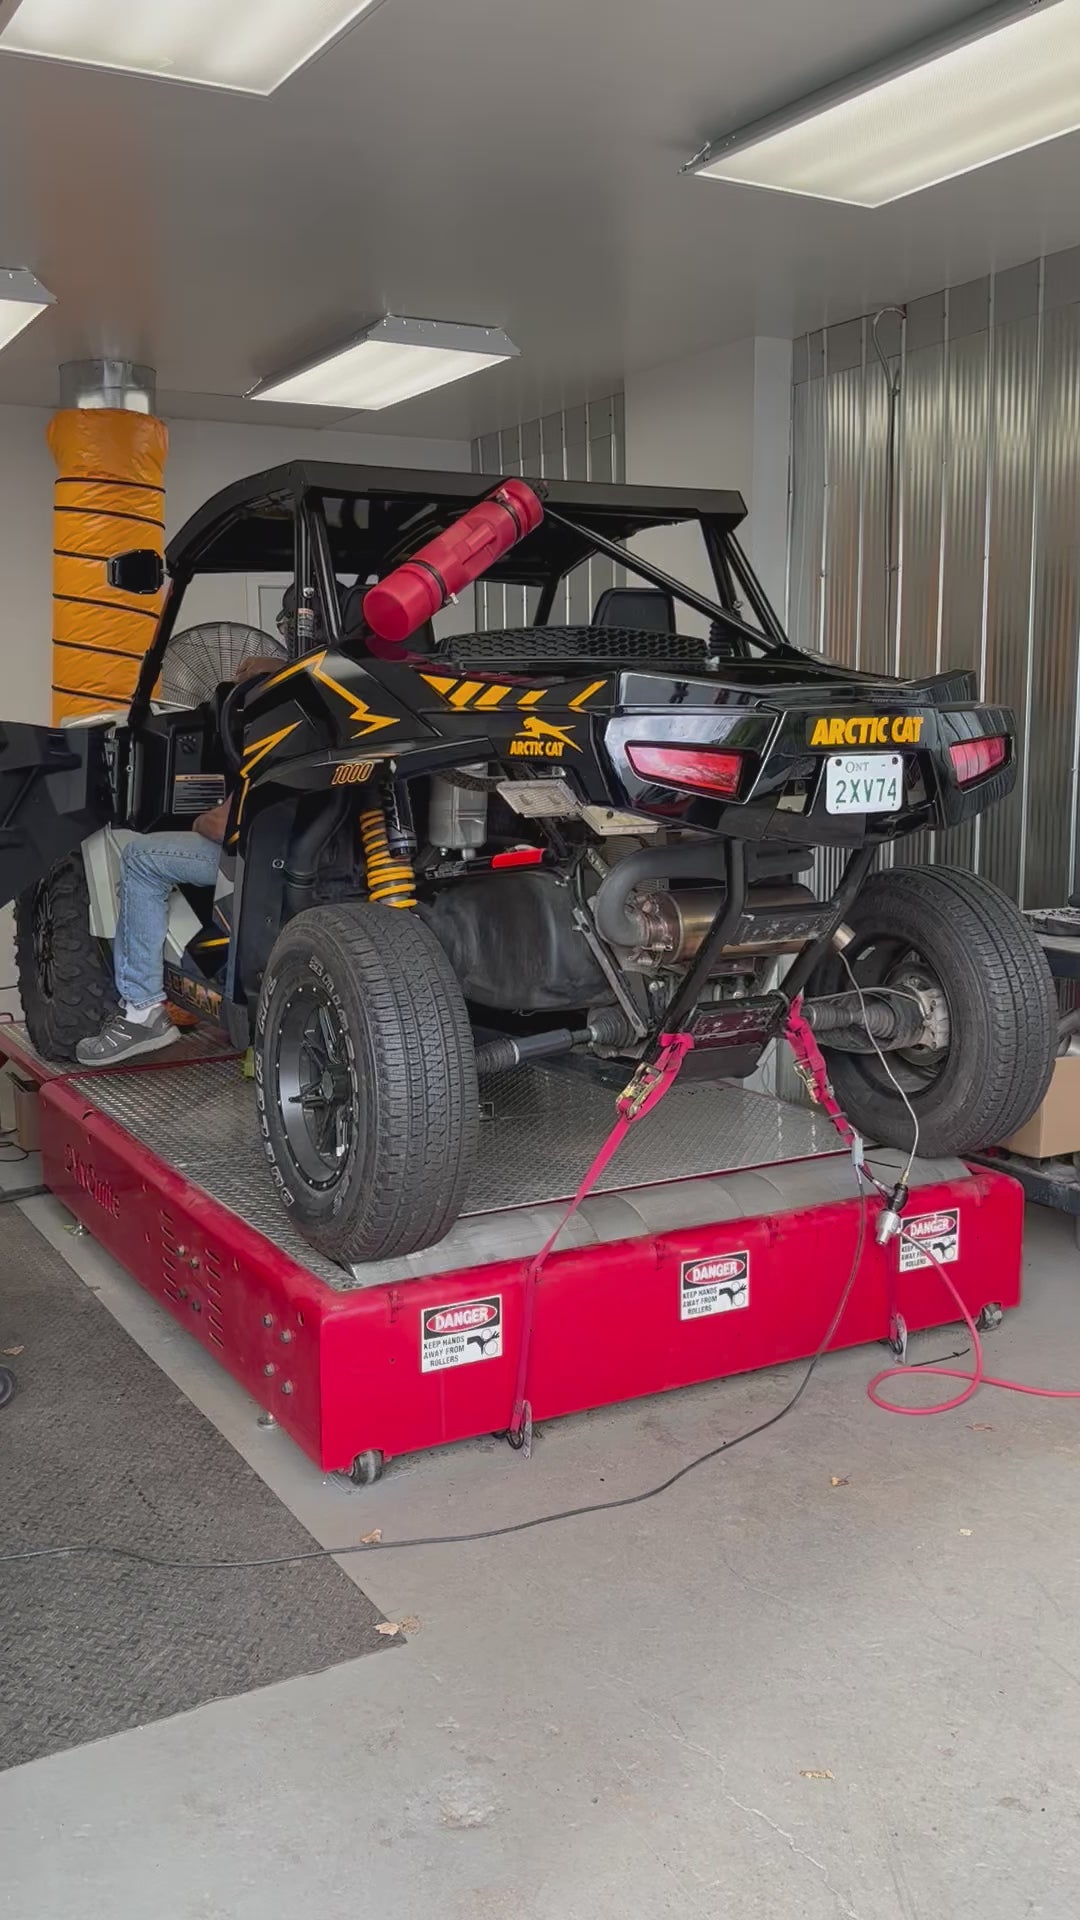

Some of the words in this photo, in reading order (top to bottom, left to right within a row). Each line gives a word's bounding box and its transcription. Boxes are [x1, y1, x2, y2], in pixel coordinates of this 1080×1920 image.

[811, 717, 889, 745] ARCTIC
[891, 716, 924, 743] CAT
[509, 741, 544, 755] ARCTIC
[545, 741, 565, 756] CAT
[331, 761, 375, 785] 1000
[835, 778, 897, 804] 2XV74
[910, 1218, 949, 1236] DANGER
[692, 1262, 738, 1282] DANGER
[683, 1291, 697, 1299] KEEP
[698, 1287, 717, 1296] HANDS
[683, 1299, 699, 1308] AWAY
[701, 1296, 718, 1304] FROM
[688, 1305, 712, 1314] ROLLERS
[434, 1307, 488, 1331] DANGER
[424, 1339, 441, 1349] KEEP
[443, 1336, 465, 1346] HANDS
[423, 1349, 443, 1360] AWAY
[445, 1345, 465, 1355] FROM
[430, 1355, 459, 1367] ROLLERS
